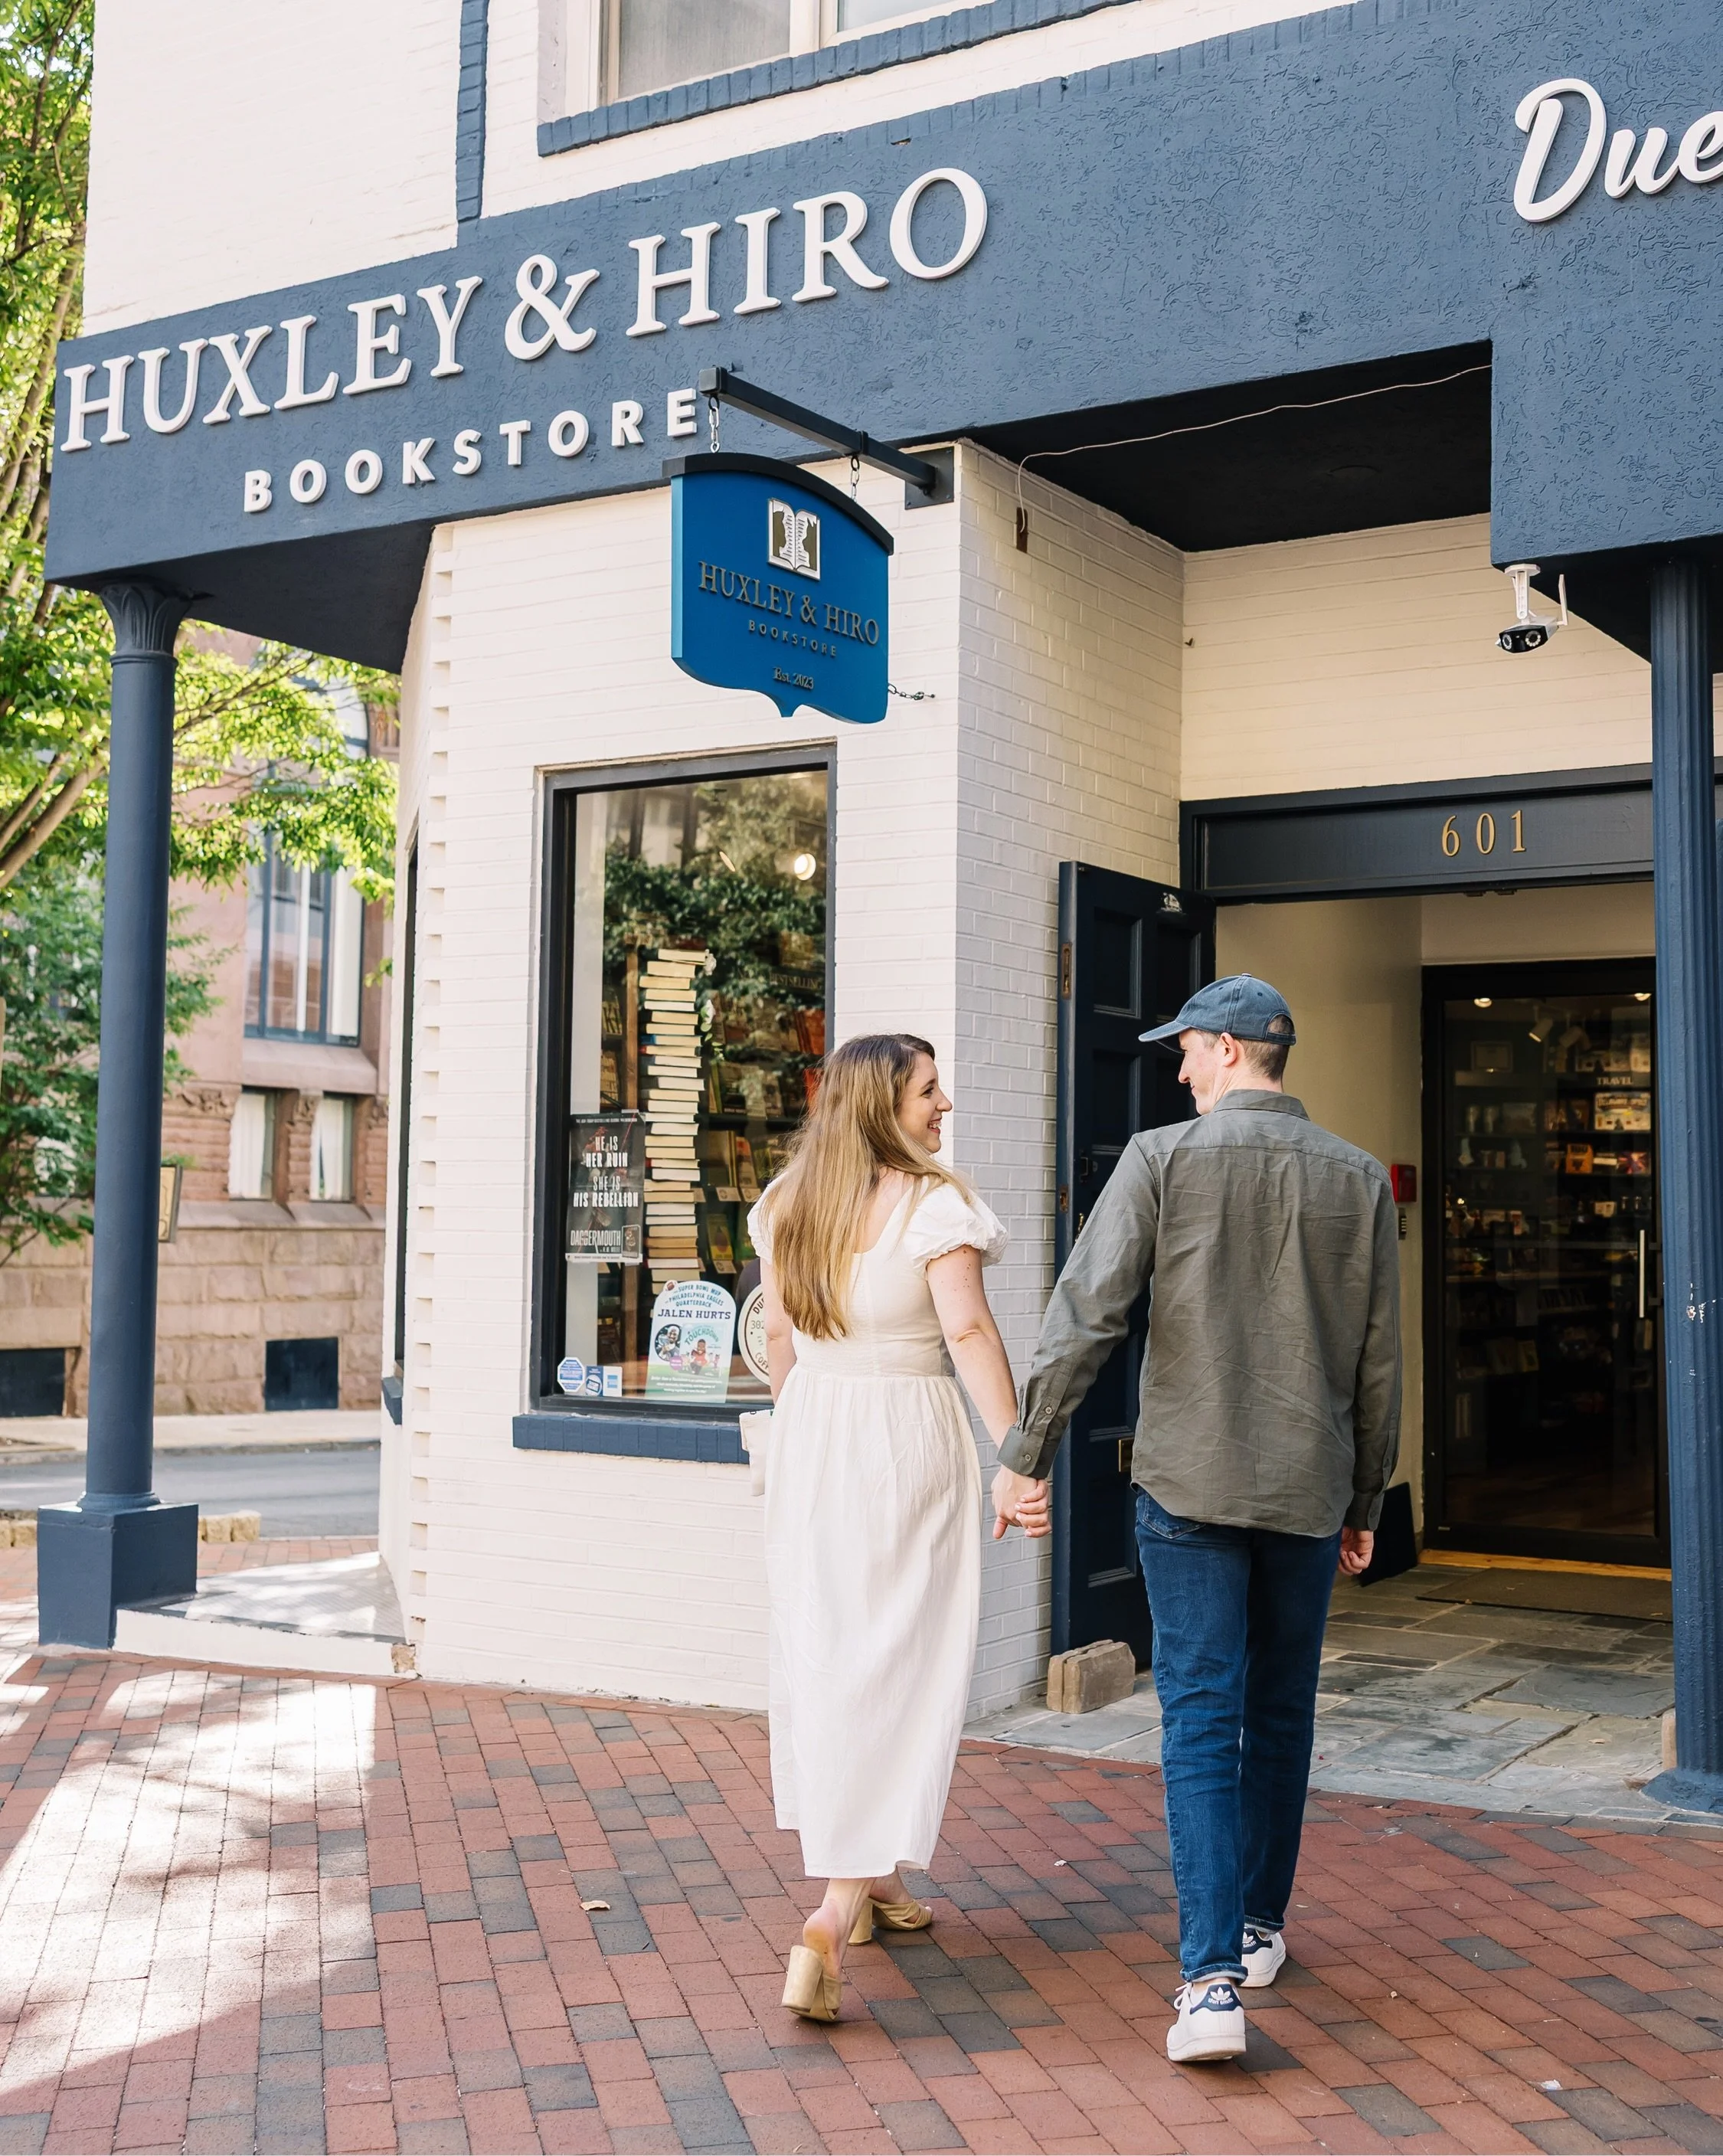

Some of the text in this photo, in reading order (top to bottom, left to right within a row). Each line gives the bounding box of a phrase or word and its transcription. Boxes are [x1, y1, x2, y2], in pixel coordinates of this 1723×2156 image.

[1513, 77, 1723, 222] Due
[60, 167, 989, 453] HUXLEY & HIRO
[244, 388, 698, 513] BOOKSTORE
[698, 561, 879, 645] HUXLEY & HIRO
[748, 620, 836, 656] BOOKSTORE
[773, 666, 814, 689] Est. 2023
[1442, 810, 1526, 856] 601
[1596, 1076, 1633, 1085] TRAVEL
[595, 1136, 618, 1151] HE IS
[586, 1152, 628, 1167] HER RUIN
[593, 1176, 620, 1191] SHE IS
[574, 1192, 639, 1207] HIS REBELLION
[571, 1230, 621, 1251] DAGGERMOUTH
[678, 1284, 693, 1292] SUPER
[669, 1292, 724, 1306] PHILADELPHIA EAGLES
[658, 1309, 731, 1320] JALEN HURTS
